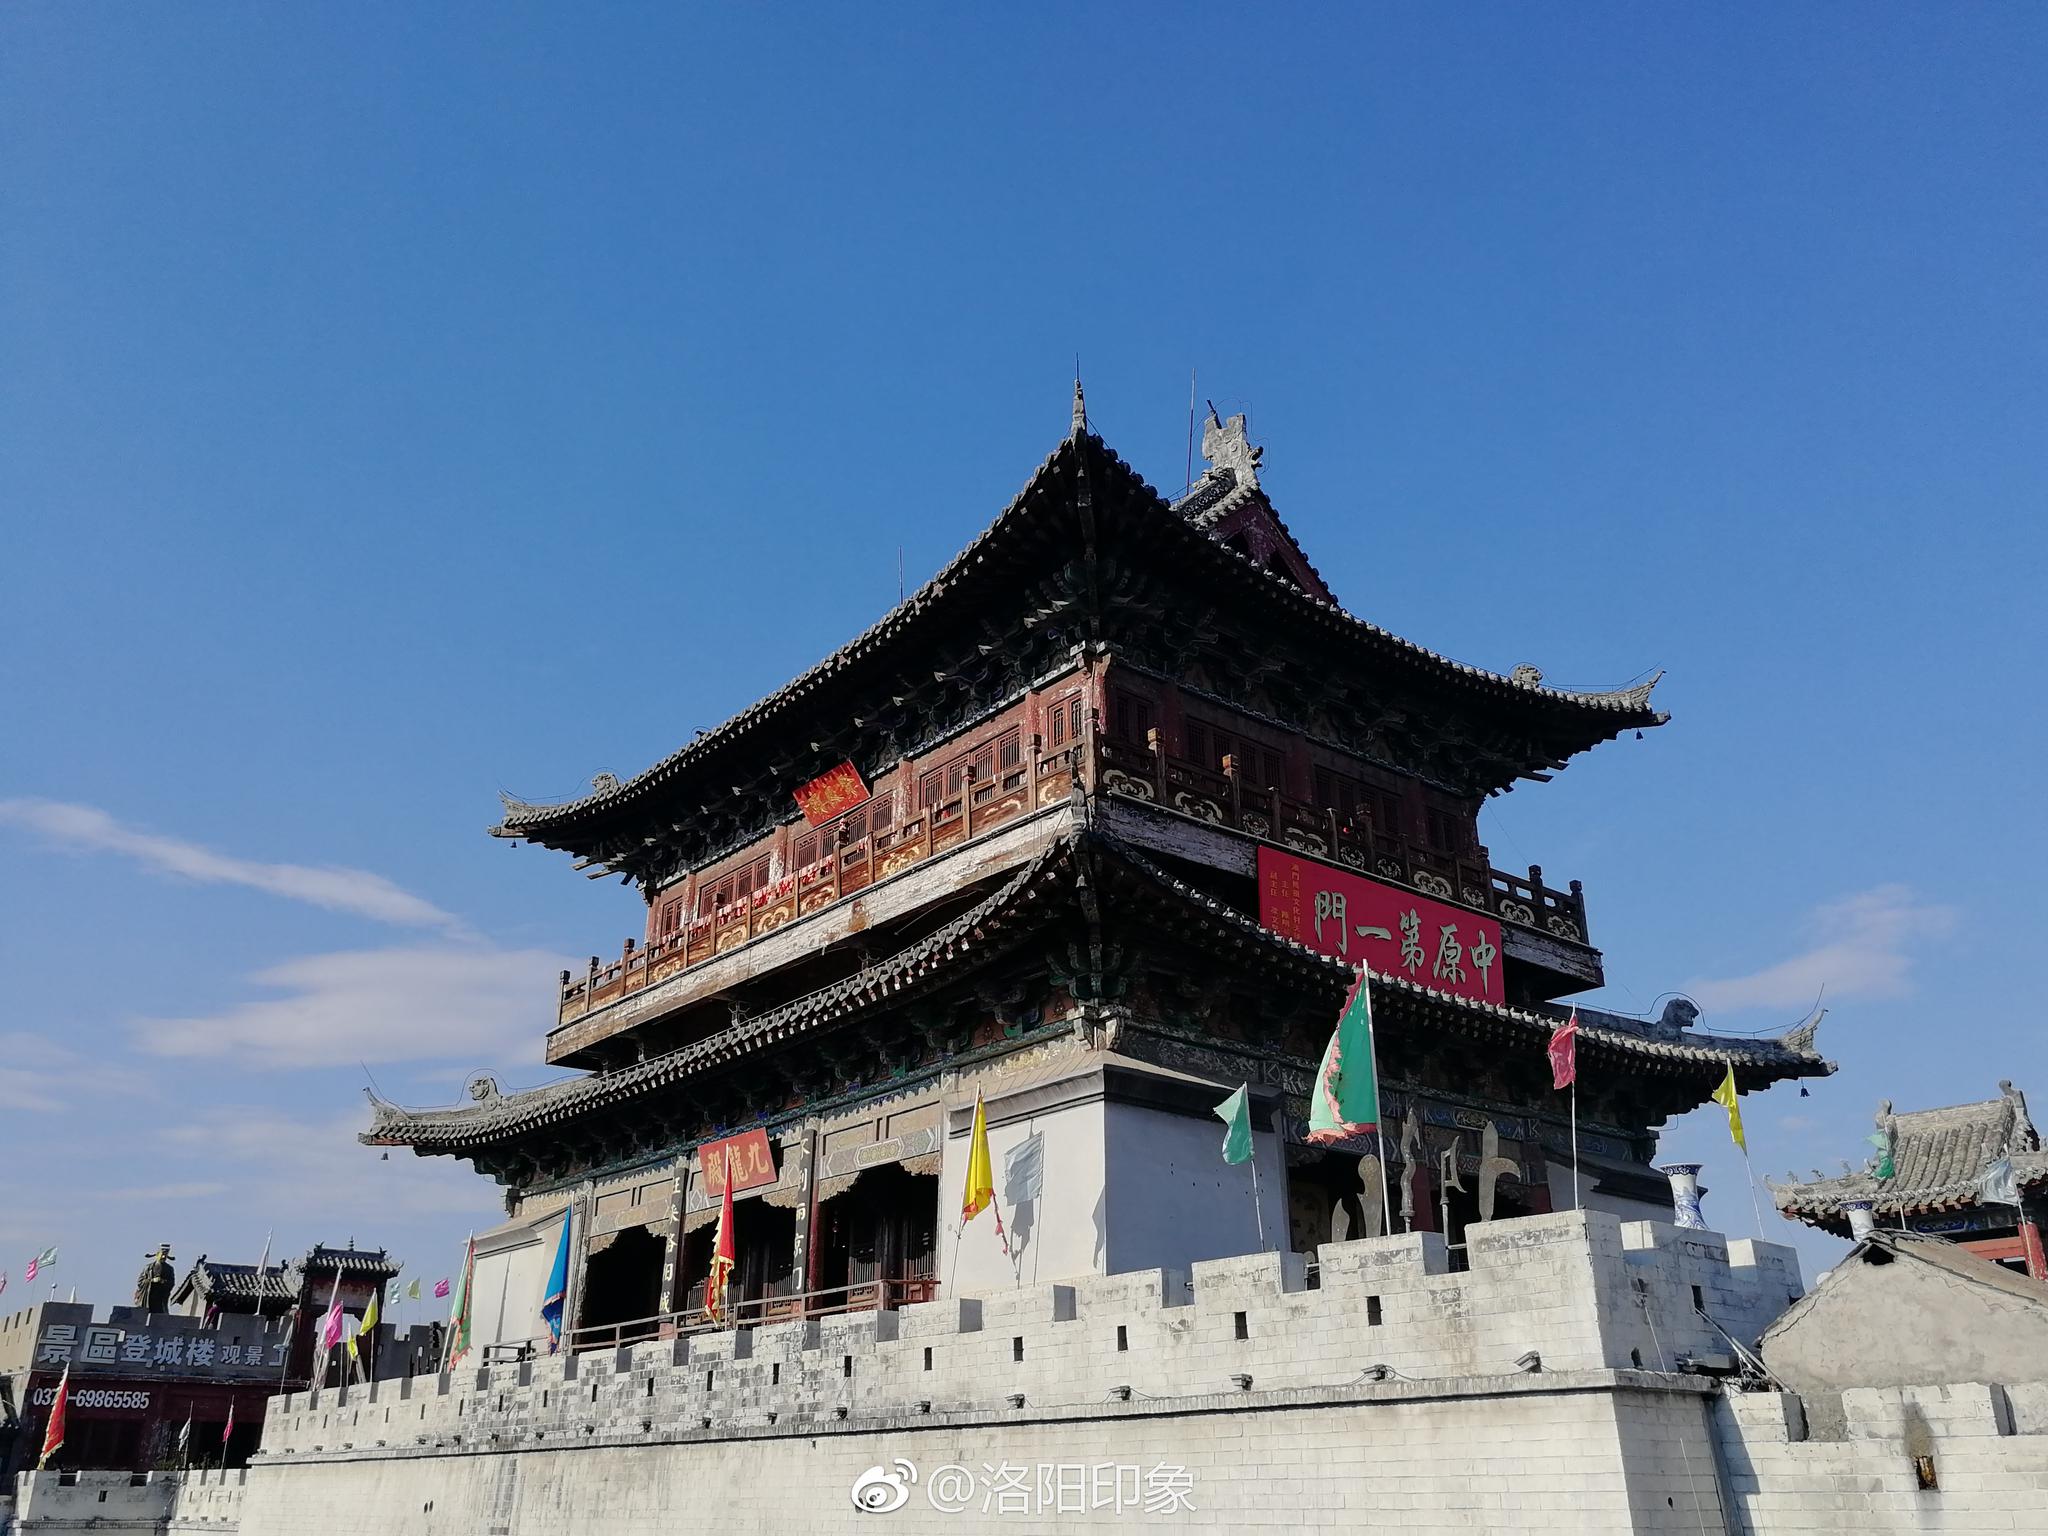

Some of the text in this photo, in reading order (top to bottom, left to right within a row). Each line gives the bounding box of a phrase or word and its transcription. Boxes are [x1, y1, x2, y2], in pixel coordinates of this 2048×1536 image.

[1314, 890, 1497, 995] 中原第一門
